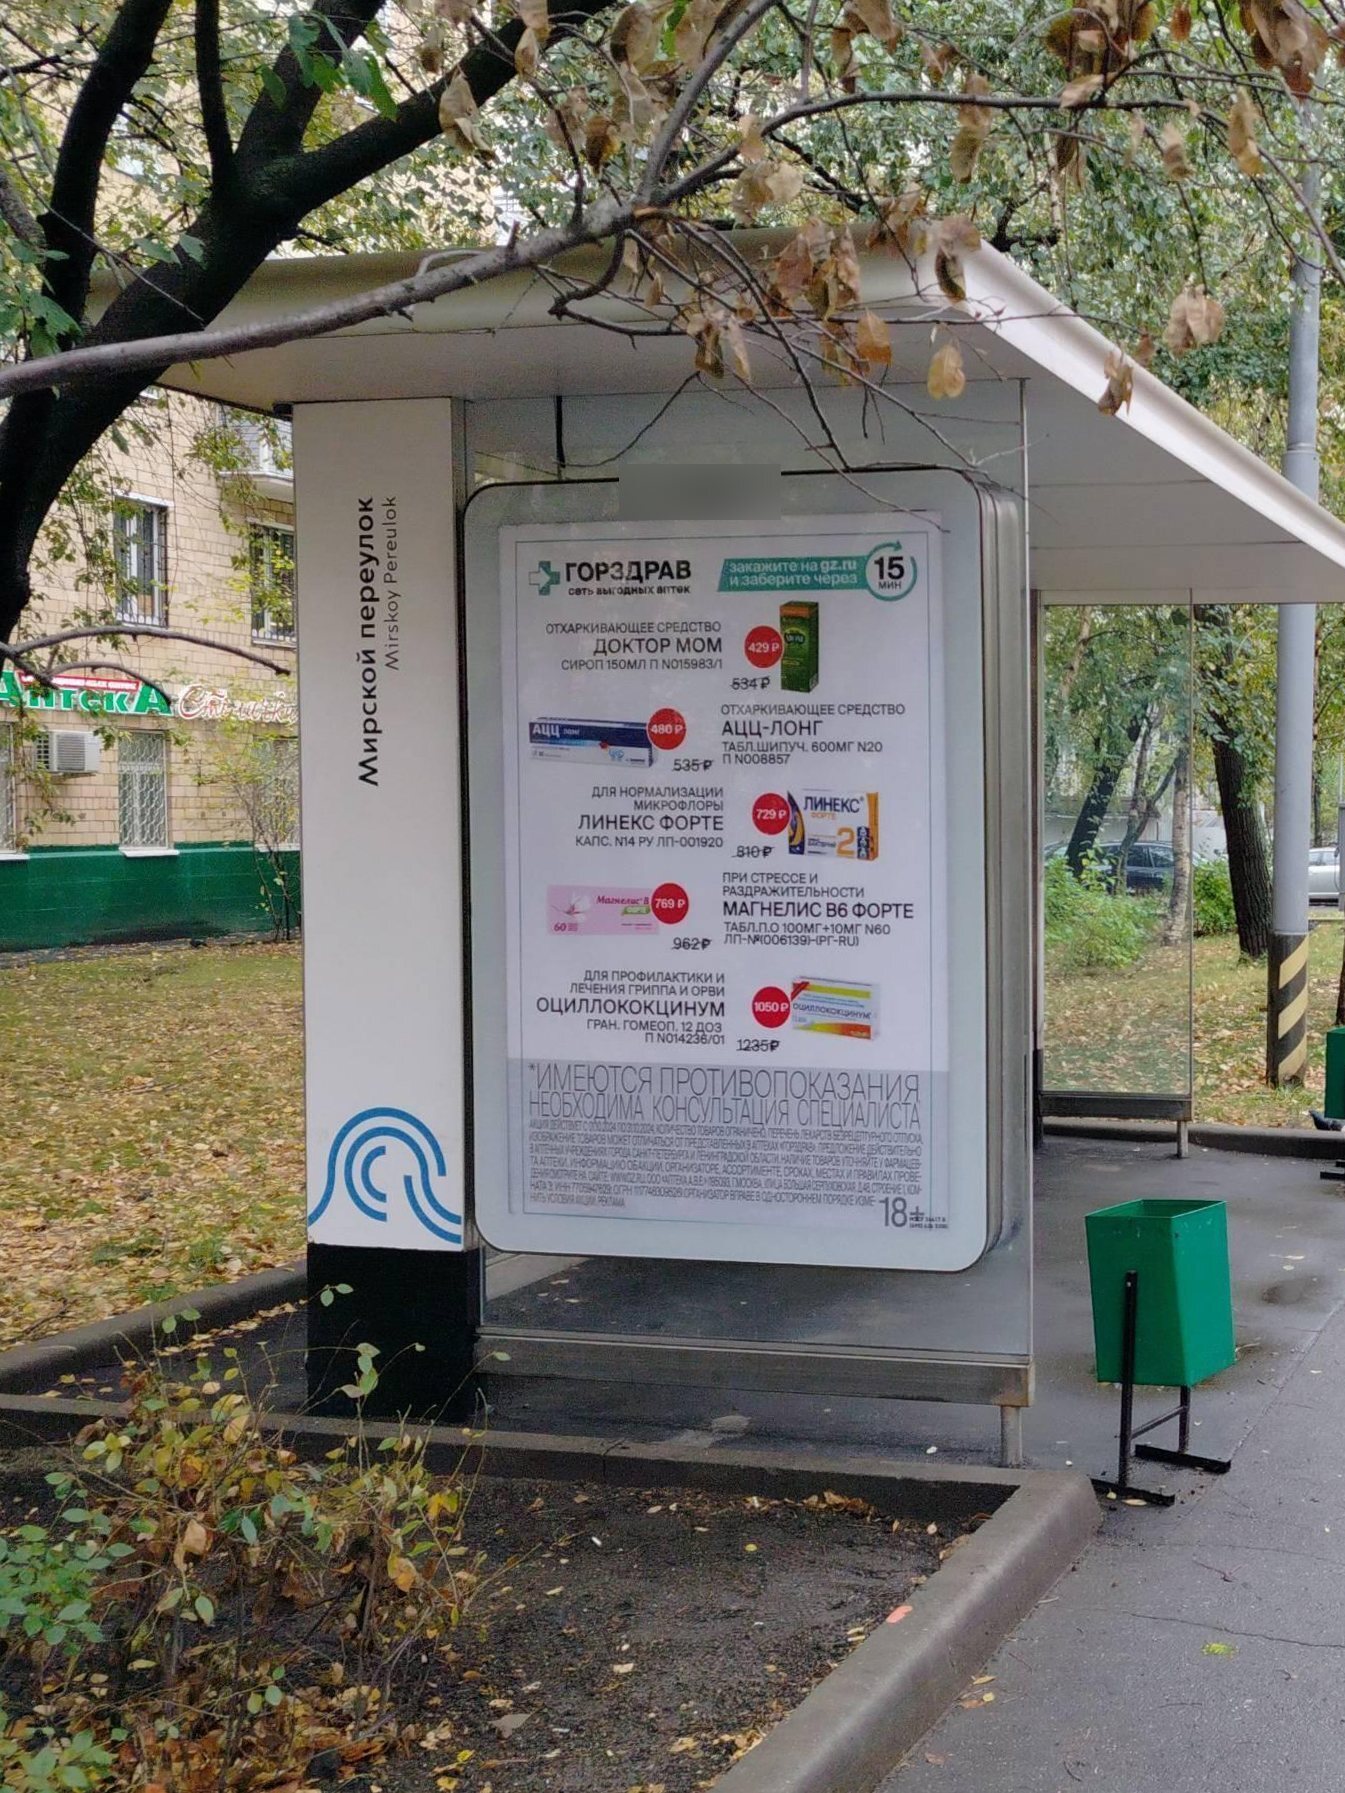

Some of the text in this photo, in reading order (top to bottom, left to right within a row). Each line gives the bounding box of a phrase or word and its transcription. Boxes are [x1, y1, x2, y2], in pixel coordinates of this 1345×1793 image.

[565, 560, 691, 583] ГОРЗДРАВ
[728, 559, 857, 573] закажите на gz.ru
[874, 555, 905, 580] 15
[382, 496, 401, 671] Mirskoy Pereulok
[729, 572, 858, 587] и заберите через
[568, 587, 593, 596] сеть
[656, 585, 691, 594] аптек
[545, 620, 721, 636] ОТХАРКИВАЮЩЕЕ СРЕДСТВО
[356, 497, 382, 786] Мирской переулок
[594, 637, 722, 657] ДОКТОР МОМ
[748, 642, 769, 653] 429
[561, 658, 722, 671] СИРОП 150МЛ П N015983/1
[721, 703, 906, 717] ОТХАРКИВАЮЩЕЕ СРЕДСТВО
[532, 723, 561, 738] АЦЦ
[650, 725, 673, 735] 480
[721, 719, 824, 738] АЦЦ-ЛОНГ
[811, 741, 855, 753] 600МГ
[857, 741, 884, 753] N20
[735, 753, 791, 765] N008857
[591, 786, 724, 799] ДЛЯ НОРМАЛИЗАЦИИ
[633, 800, 724, 811] МИКРОФЛОРЫ
[756, 809, 777, 820] 729
[578, 815, 724, 831] ЛИНЕКС ФОРТЕ
[575, 836, 724, 848] КАПС. N14 РУ ЛП-001920
[836, 827, 855, 857] 2
[722, 872, 818, 884] ПРИ СТРЕССЕ И
[722, 885, 865, 898] РАЗДРАЖИТЕЛЬНОСТИ
[655, 898, 676, 909] 769
[723, 901, 822, 918] МАГНЕЛИС
[852, 902, 914, 919] ФОРТЕ
[783, 922, 862, 935] 100МГ+10МГ
[865, 923, 891, 935] N60
[583, 970, 725, 984] ДЛЯ ПРОФИЛАКТИКИ И
[569, 983, 725, 997] ЛЕЧЕНИЯ ГРИППА И ОРВИ
[536, 996, 725, 1018] ОЦИЛЛОКОКЦИНУМ
[754, 1001, 779, 1013] 1050
[587, 1019, 722, 1036] ГРАН. ГОМЕОП. 12 ДОЗ
[657, 1032, 725, 1045] N014236/01
[660, 1066, 920, 1102] ПРОТИВОПОКАЗАНИЯ
[529, 1091, 643, 1119] НЕОБХОДИМА
[652, 1095, 788, 1127] КОНСУЛЬТАЦИЯ
[797, 1099, 920, 1132] СПЕЦИАЛИСТА
